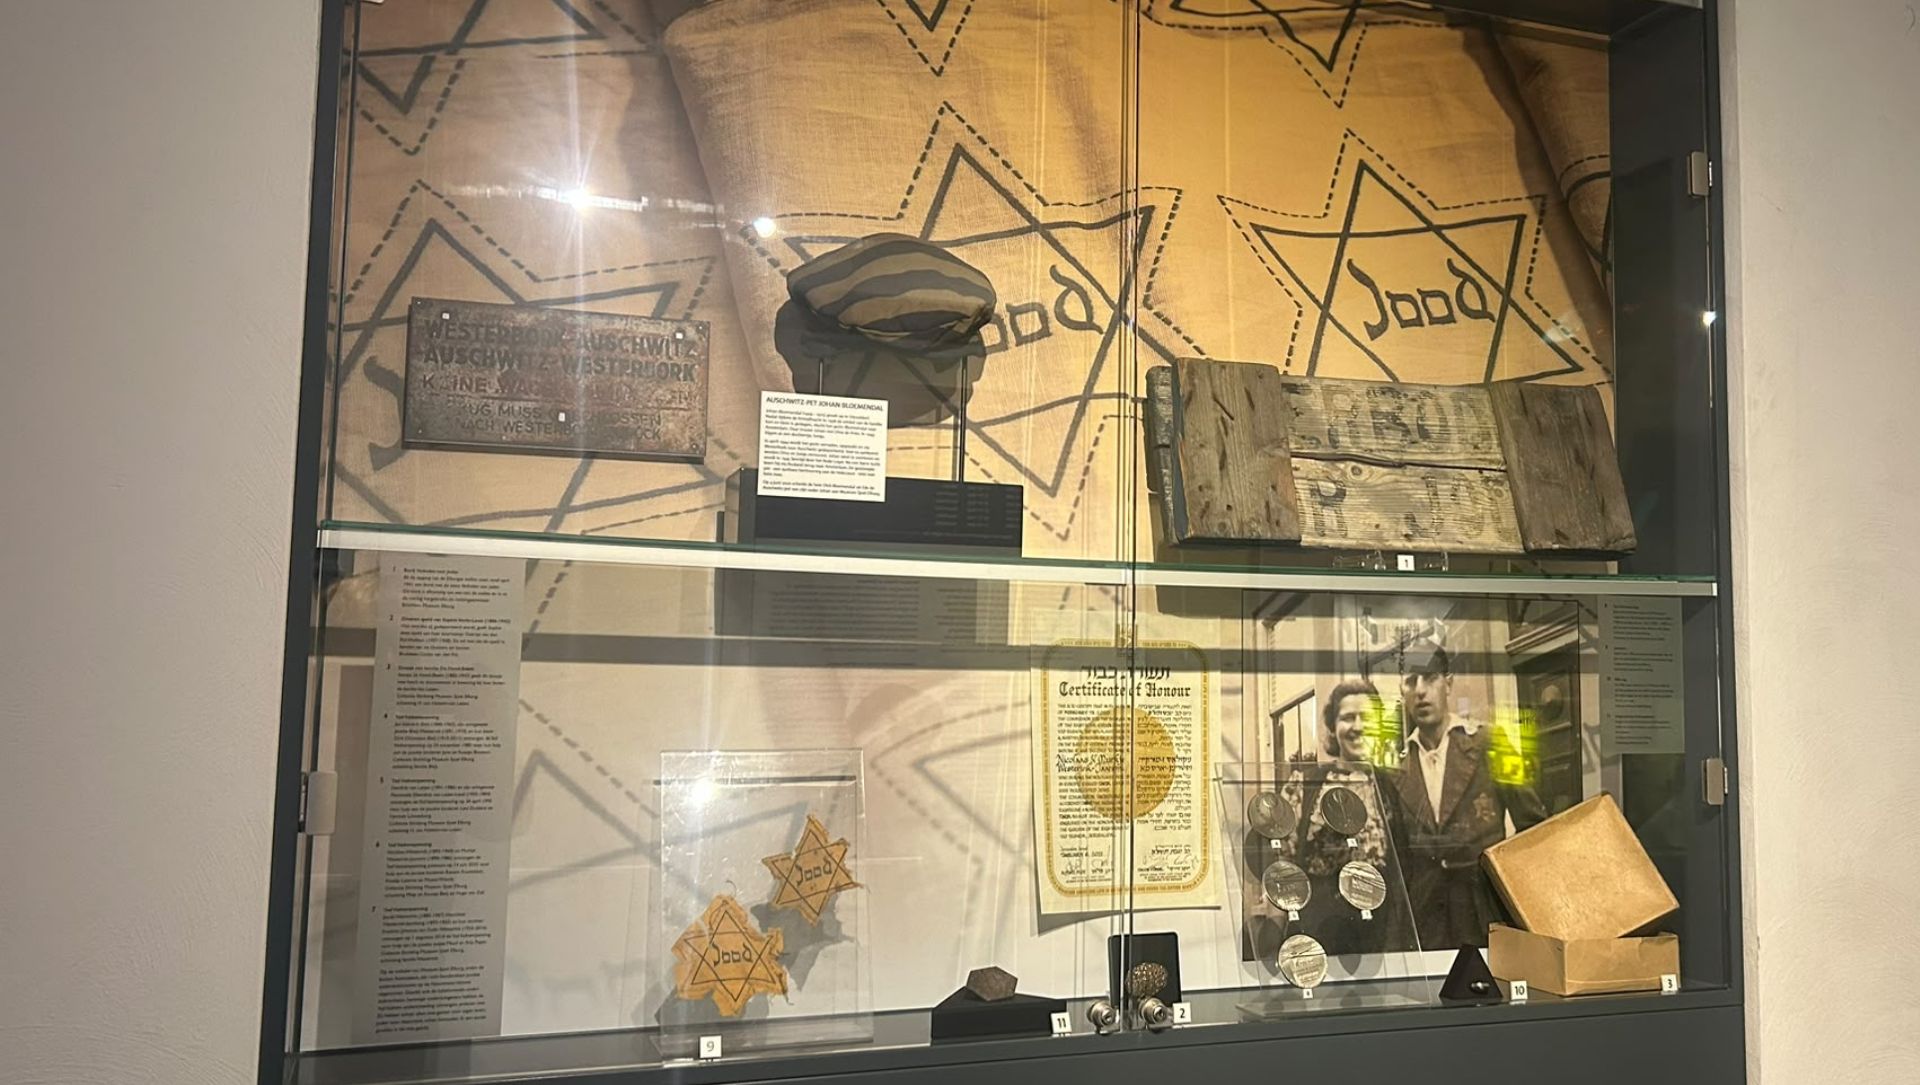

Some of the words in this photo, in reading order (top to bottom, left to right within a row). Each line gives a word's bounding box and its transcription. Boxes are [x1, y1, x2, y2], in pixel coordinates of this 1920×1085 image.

[1347, 258, 1495, 341] Jood
[766, 396, 805, 406] AUSCHWITZ
[819, 401, 840, 409] JOHAN
[842, 402, 883, 412] BLOEMENDAL
[1404, 559, 1409, 568] 1
[1059, 681, 1125, 697] Certificate
[1128, 682, 1142, 697] of
[1146, 682, 1191, 698] Honour
[795, 856, 832, 887] Jood
[712, 942, 753, 968] Jood
[1667, 978, 1673, 988] 3
[1514, 985, 1525, 996] 10
[1179, 1008, 1186, 1018] 2
[1057, 1017, 1066, 1028] 11
[706, 1040, 715, 1052] 9
